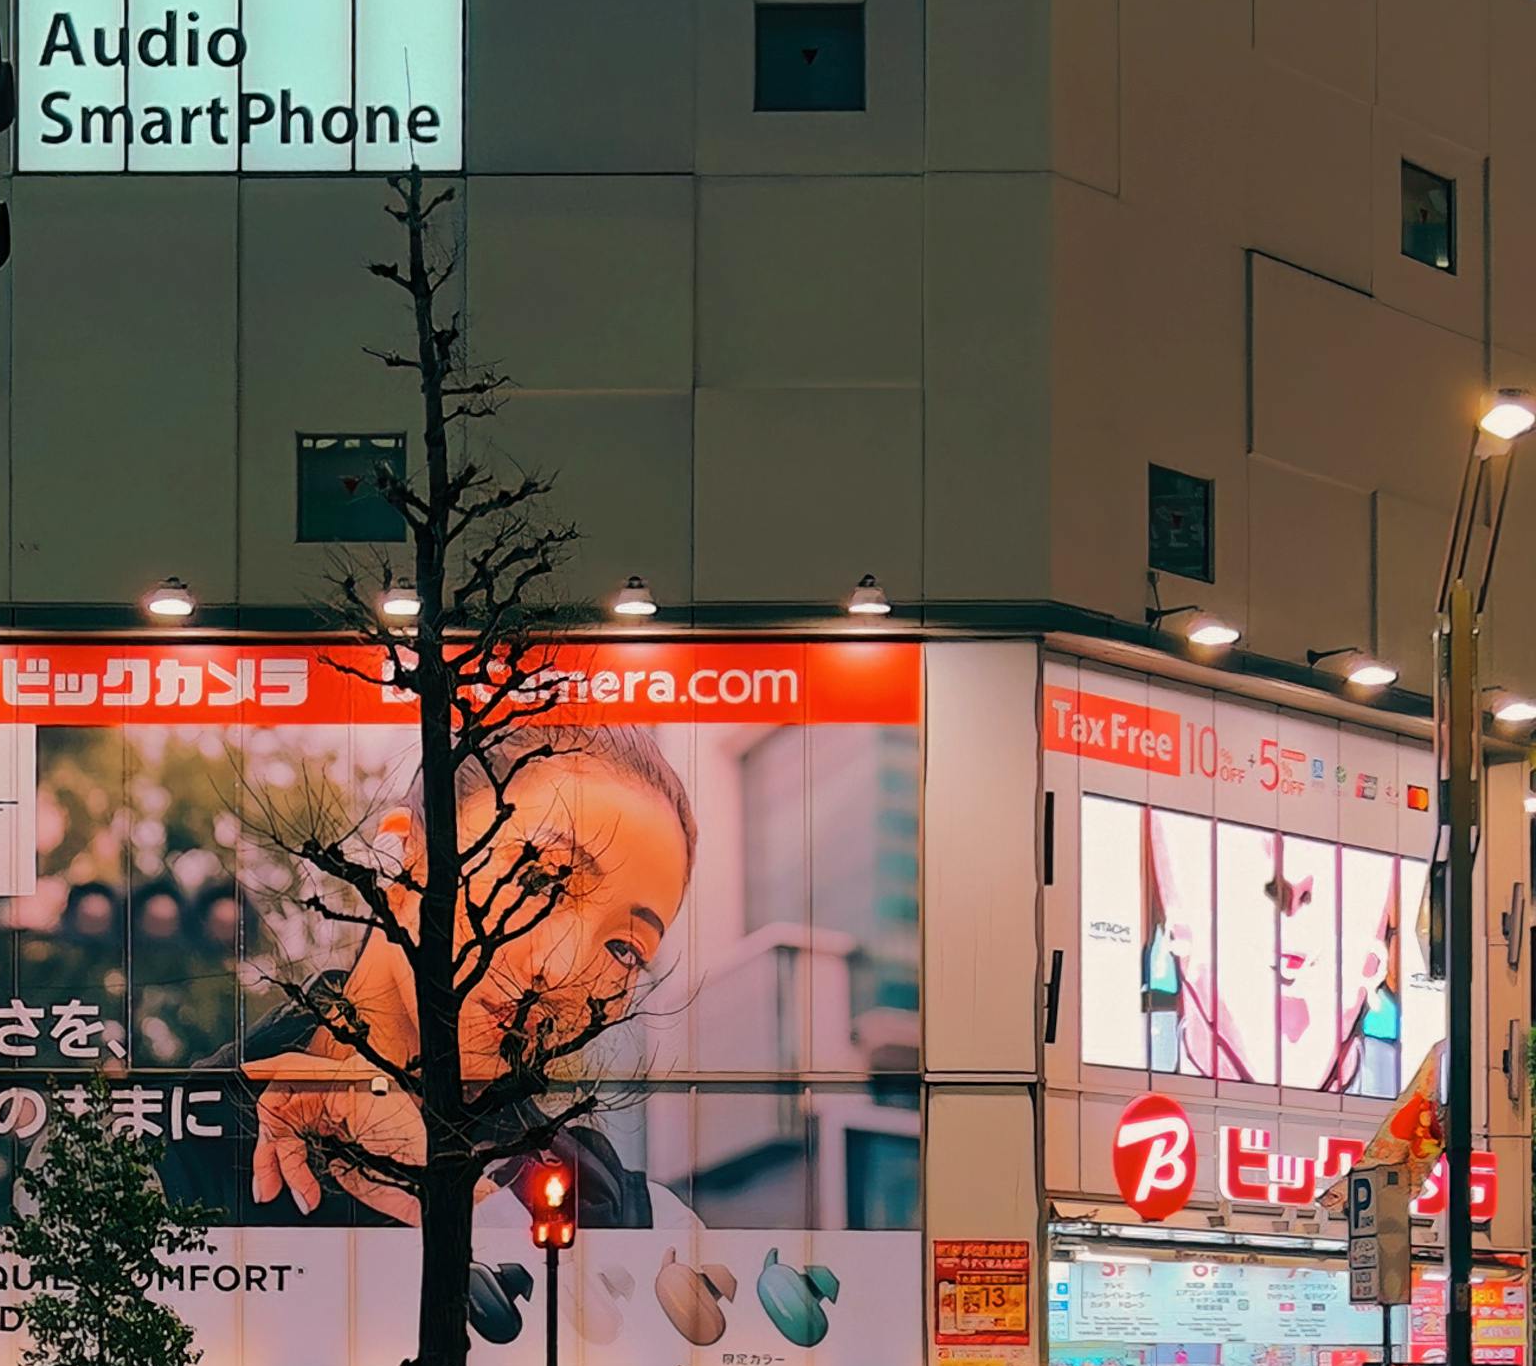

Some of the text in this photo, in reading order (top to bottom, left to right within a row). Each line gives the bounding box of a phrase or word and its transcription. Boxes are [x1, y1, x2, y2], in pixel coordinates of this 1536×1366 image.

[39, 10, 248, 68] Audio
[40, 89, 441, 145] SmartPhone
[2, 658, 309, 707] ビックカメラ
[1052, 700, 1106, 747] Tax
[1110, 713, 1174, 762] Free
[1187, 722, 1218, 780] 10
[1353, 1177, 1372, 1229] P
[722, 1352, 786, 1366] 限定カラー
